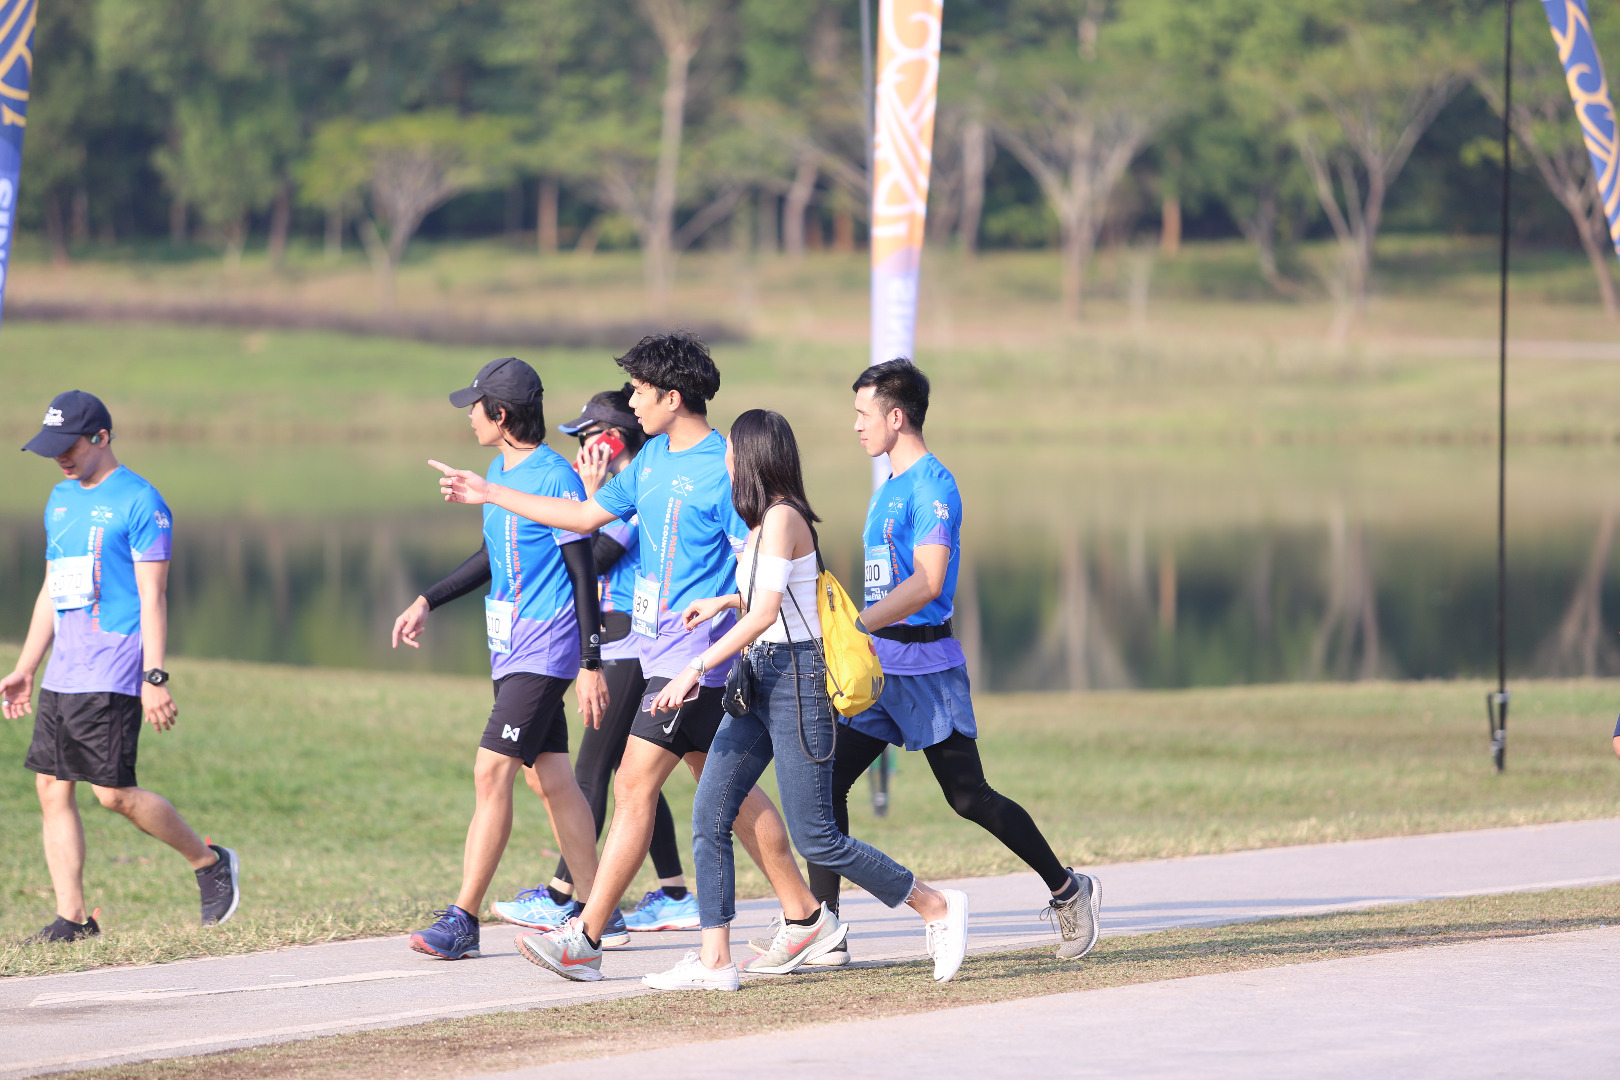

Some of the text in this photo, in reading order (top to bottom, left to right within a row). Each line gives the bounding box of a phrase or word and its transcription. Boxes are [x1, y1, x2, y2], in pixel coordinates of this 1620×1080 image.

[665, 496, 674, 524] CROSS
[88, 525, 96, 551] CROSS
[94, 526, 104, 559] SINGHA
[511, 516, 519, 549] SINGHA
[505, 541, 513, 579] COUNTRY
[512, 550, 521, 573] PARK
[660, 498, 682, 613] SINGHA PARK CHIANG RAI
[891, 552, 900, 576] PARK
[94, 560, 102, 583] PARK
